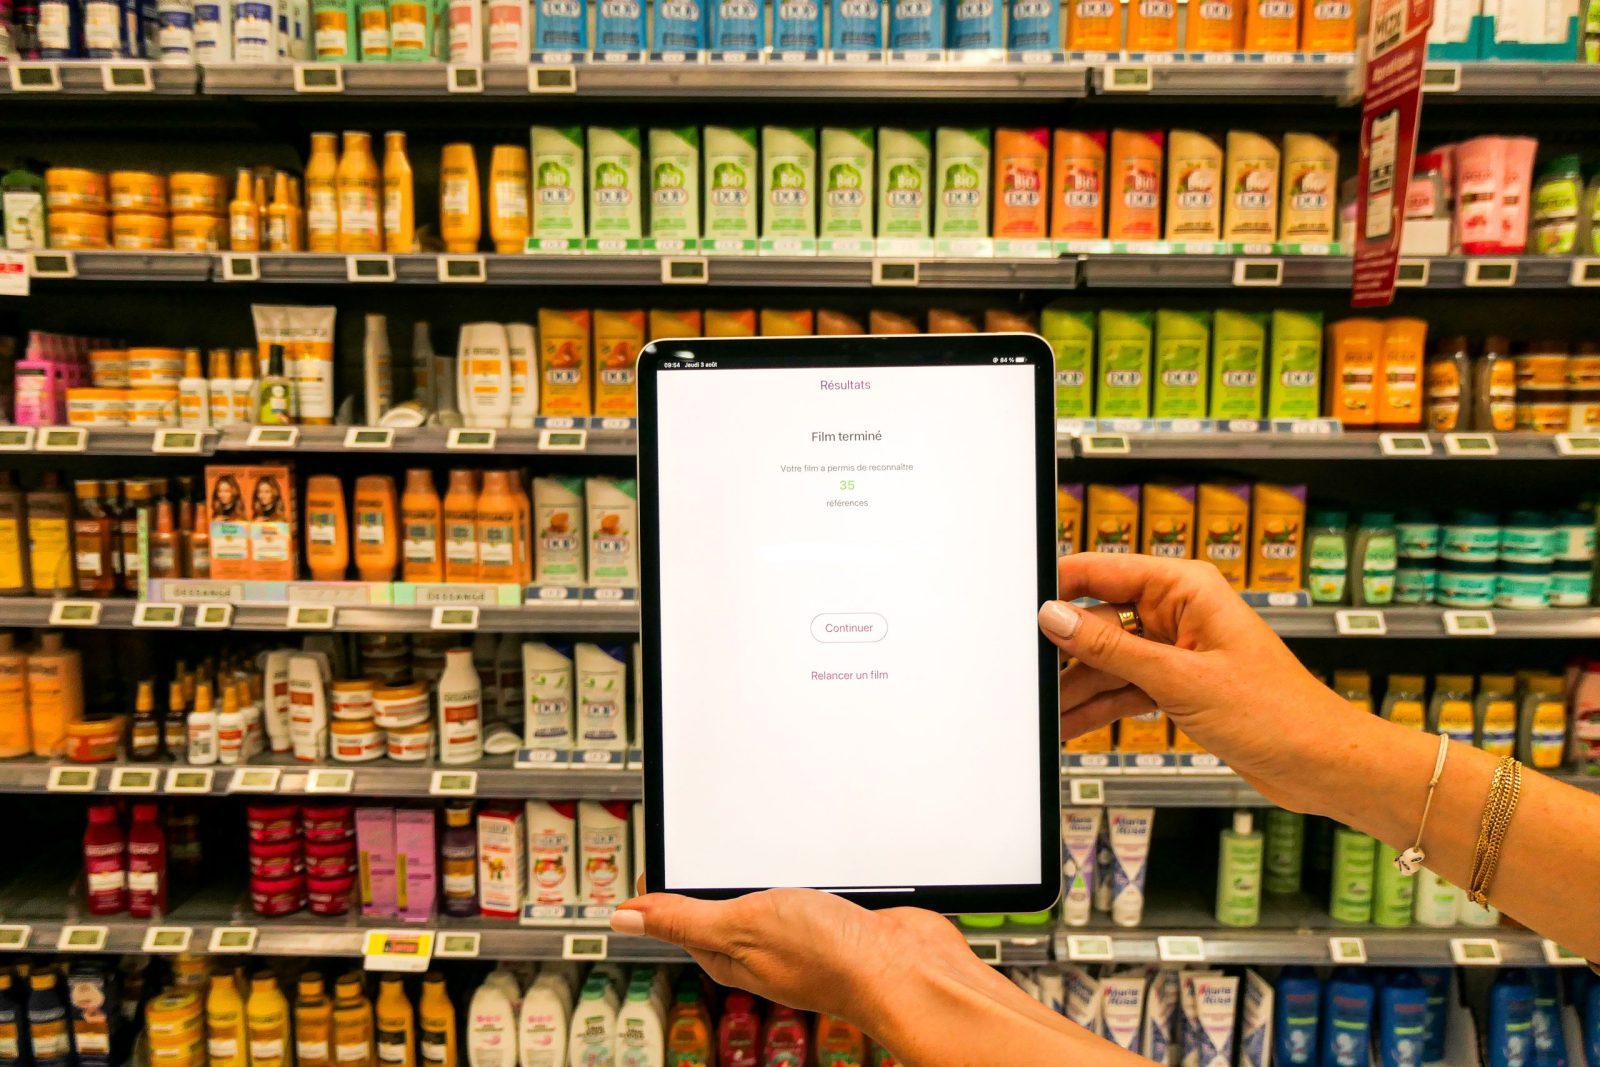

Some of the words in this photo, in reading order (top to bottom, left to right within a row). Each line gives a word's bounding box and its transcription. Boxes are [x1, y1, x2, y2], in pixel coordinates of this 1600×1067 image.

[820, 379, 871, 391] Résultats
[811, 431, 836, 442] Film
[838, 430, 883, 442] terminé
[780, 464, 802, 473] Votre
[803, 463, 818, 472] film
[827, 463, 855, 475] permis
[856, 463, 867, 472] de
[868, 462, 914, 472] reconnaître
[839, 480, 855, 491] 35
[826, 498, 869, 508] références
[825, 622, 873, 633] Continuer
[811, 670, 854, 681] Relancer
[855, 672, 868, 680] un
[870, 669, 889, 680] film
